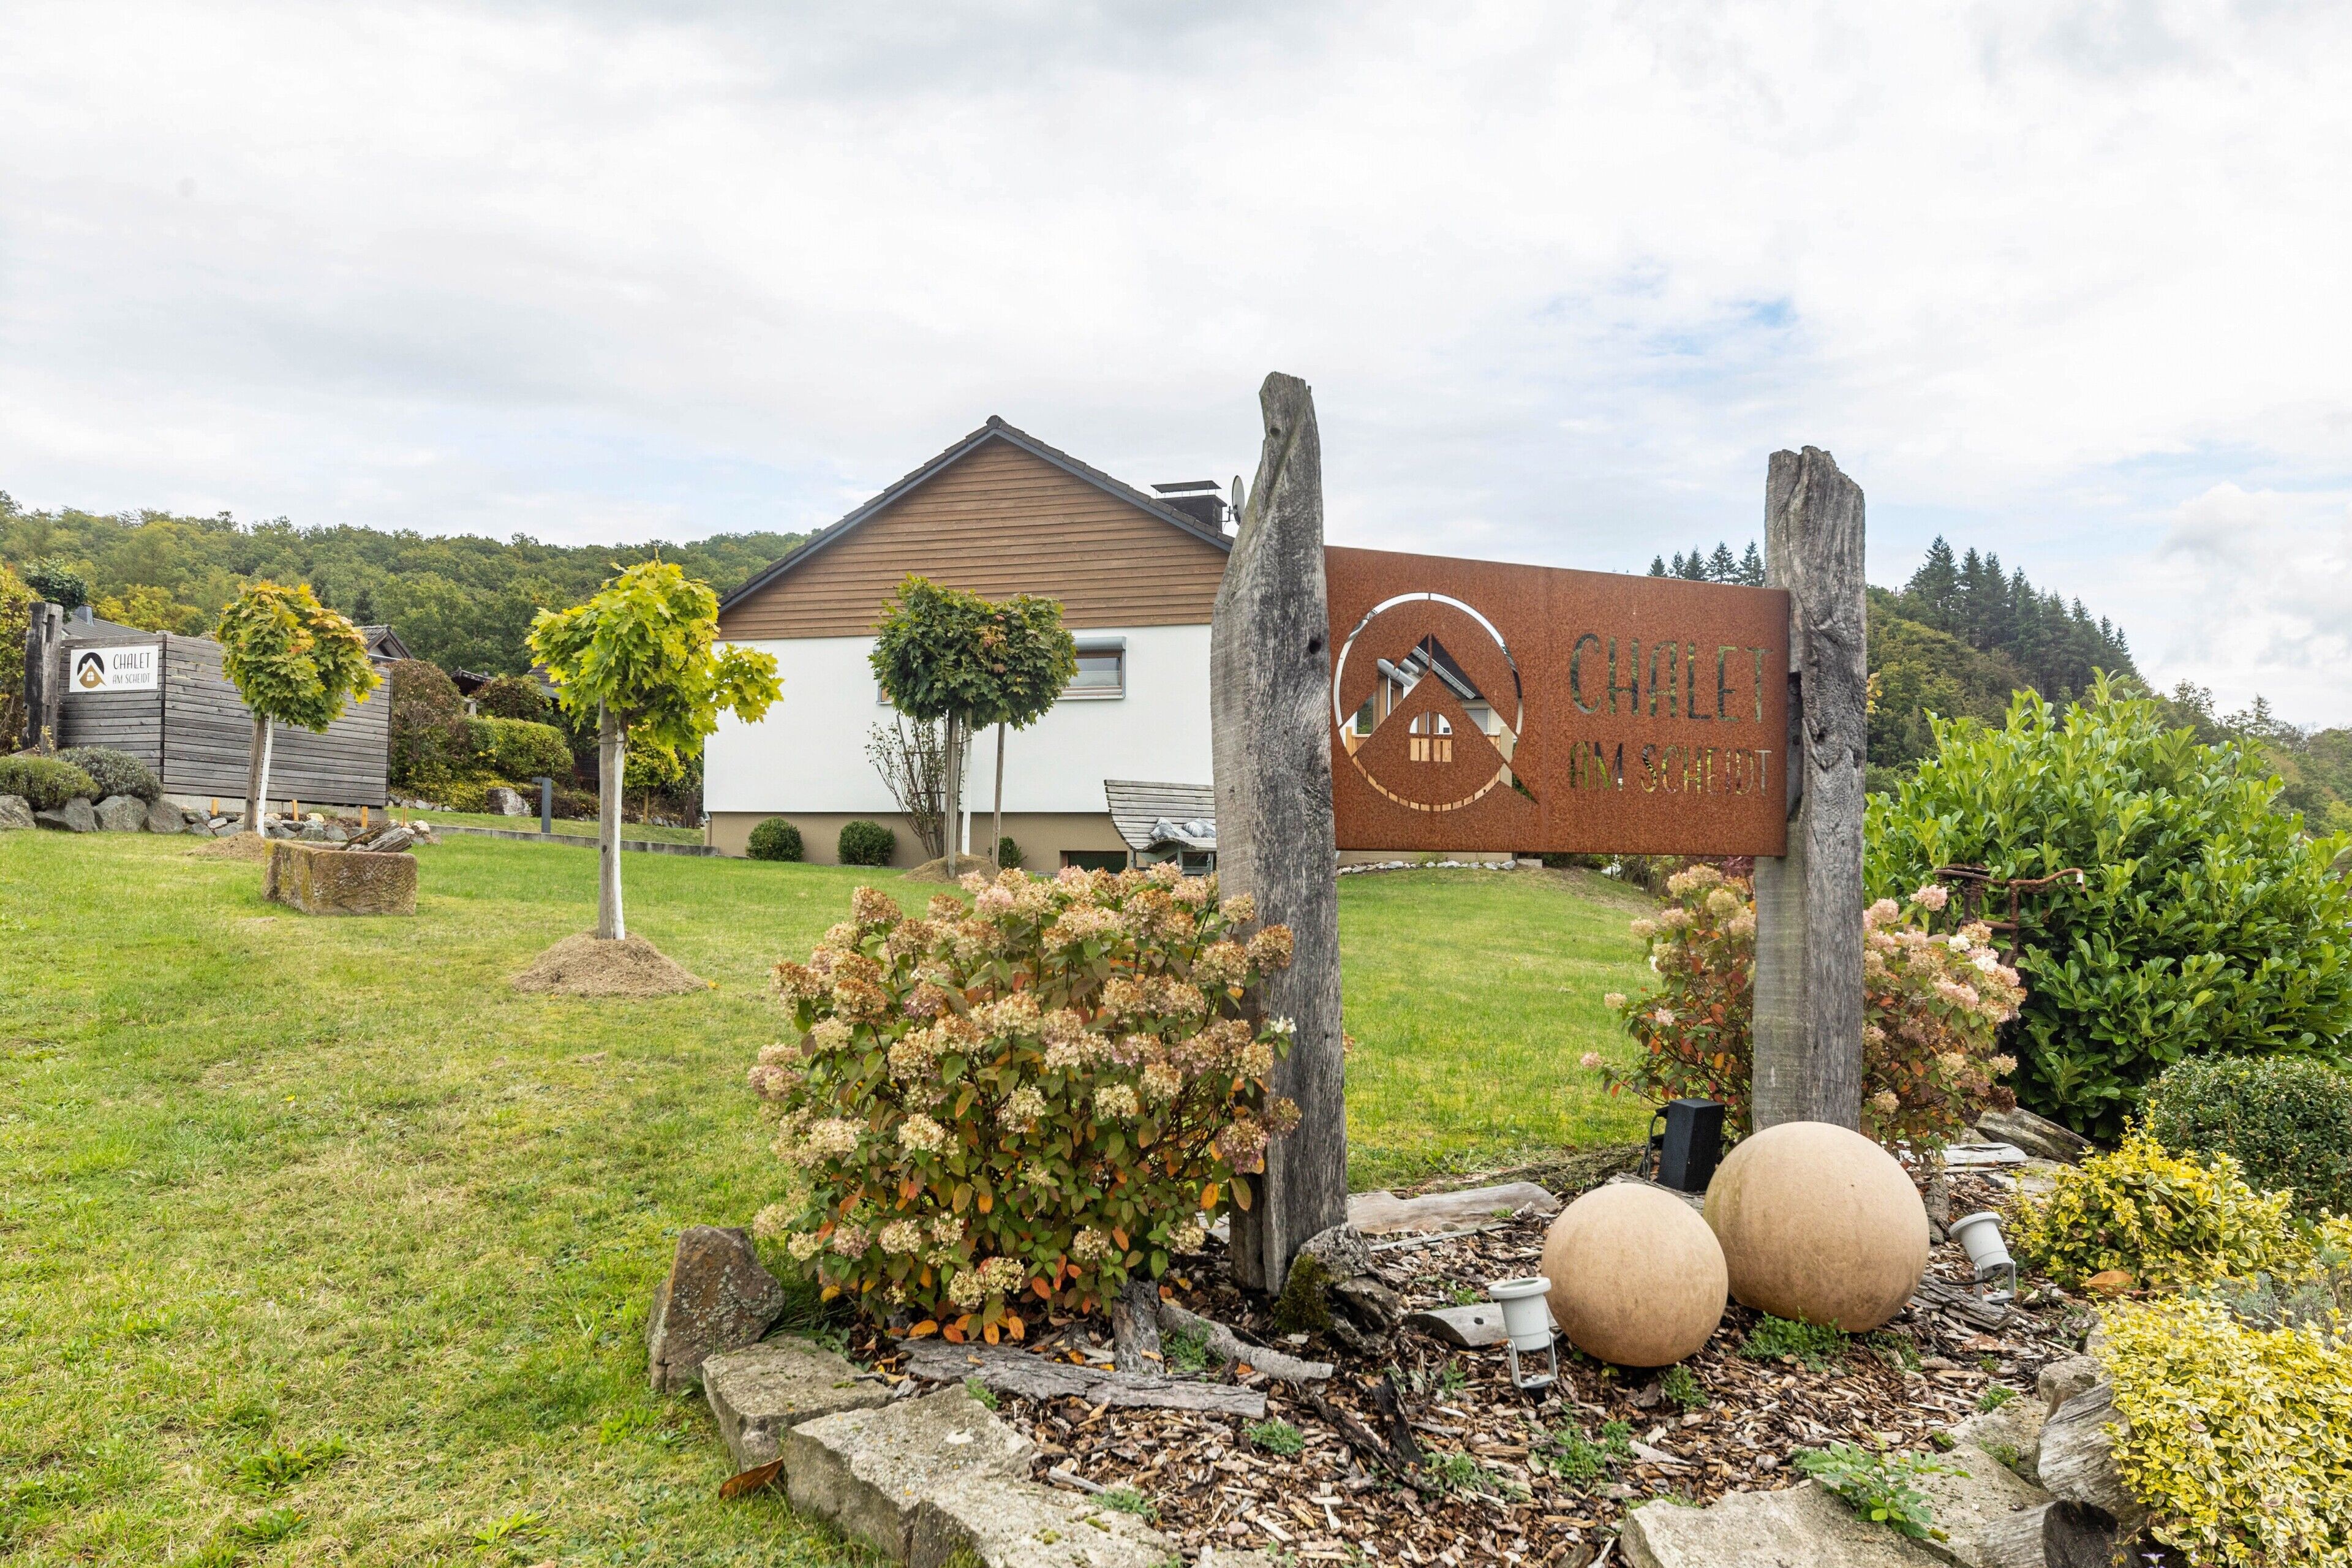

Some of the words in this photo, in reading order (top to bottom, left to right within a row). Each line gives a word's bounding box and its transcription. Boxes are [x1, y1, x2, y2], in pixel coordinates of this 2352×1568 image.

[113, 652, 151, 669] CHALET
[113, 674, 123, 684] AM
[125, 673, 149, 684] SCHEIDT
[1569, 633, 1773, 723] CHALET
[1569, 741, 1623, 791] AM
[1640, 743, 1773, 796] SCHEIDT
